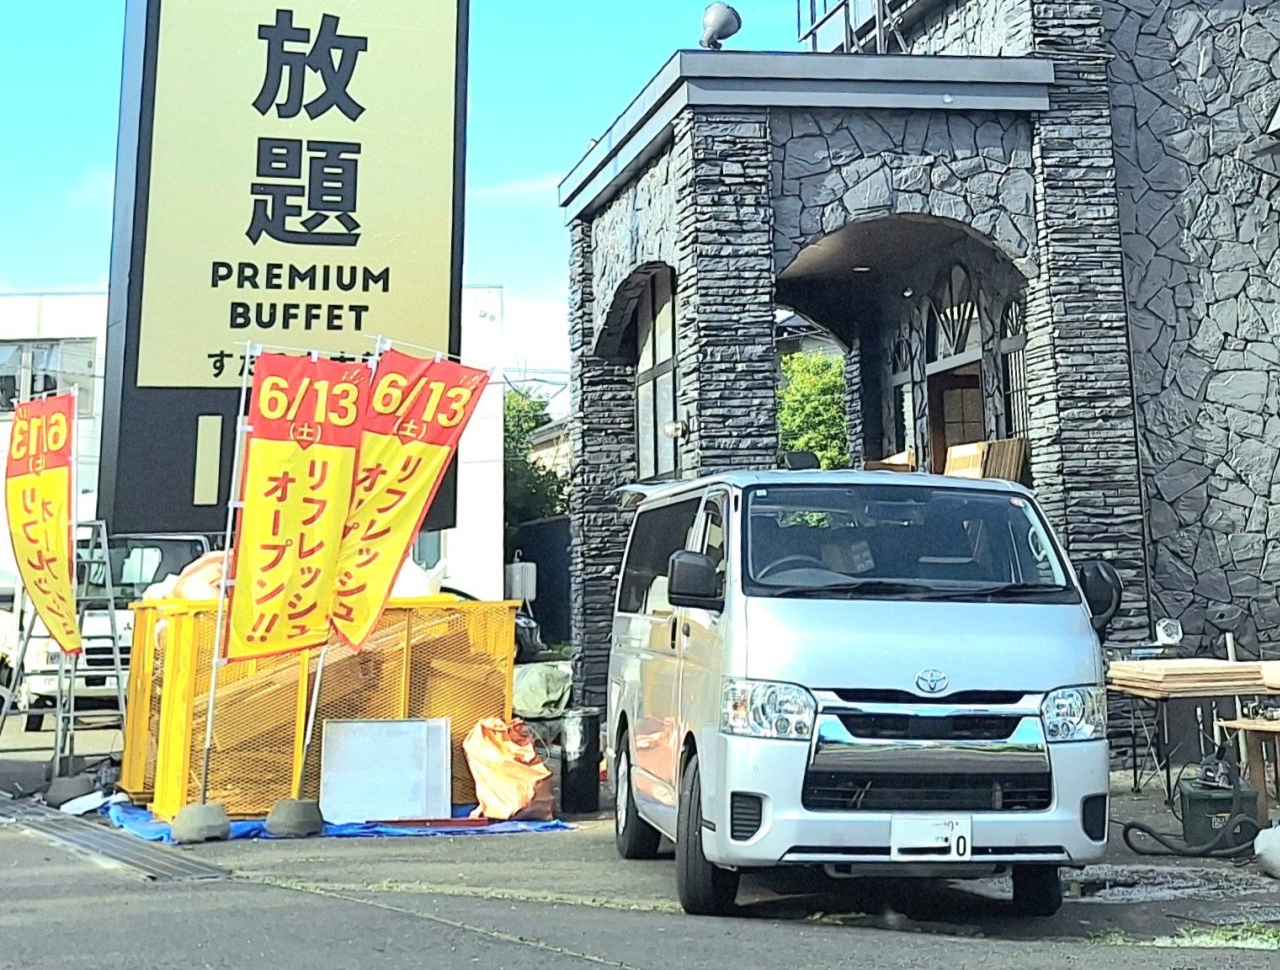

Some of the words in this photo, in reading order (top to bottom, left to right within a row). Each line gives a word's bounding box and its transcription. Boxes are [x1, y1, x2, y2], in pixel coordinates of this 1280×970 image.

[210, 261, 390, 293] PREMIUM
[229, 302, 370, 332] BUFFET
[258, 375, 359, 427] 6/13
[372, 372, 472, 428] 6/13
[287, 459, 328, 639] リフレッシュ
[333, 455, 422, 623] リフレッシュ
